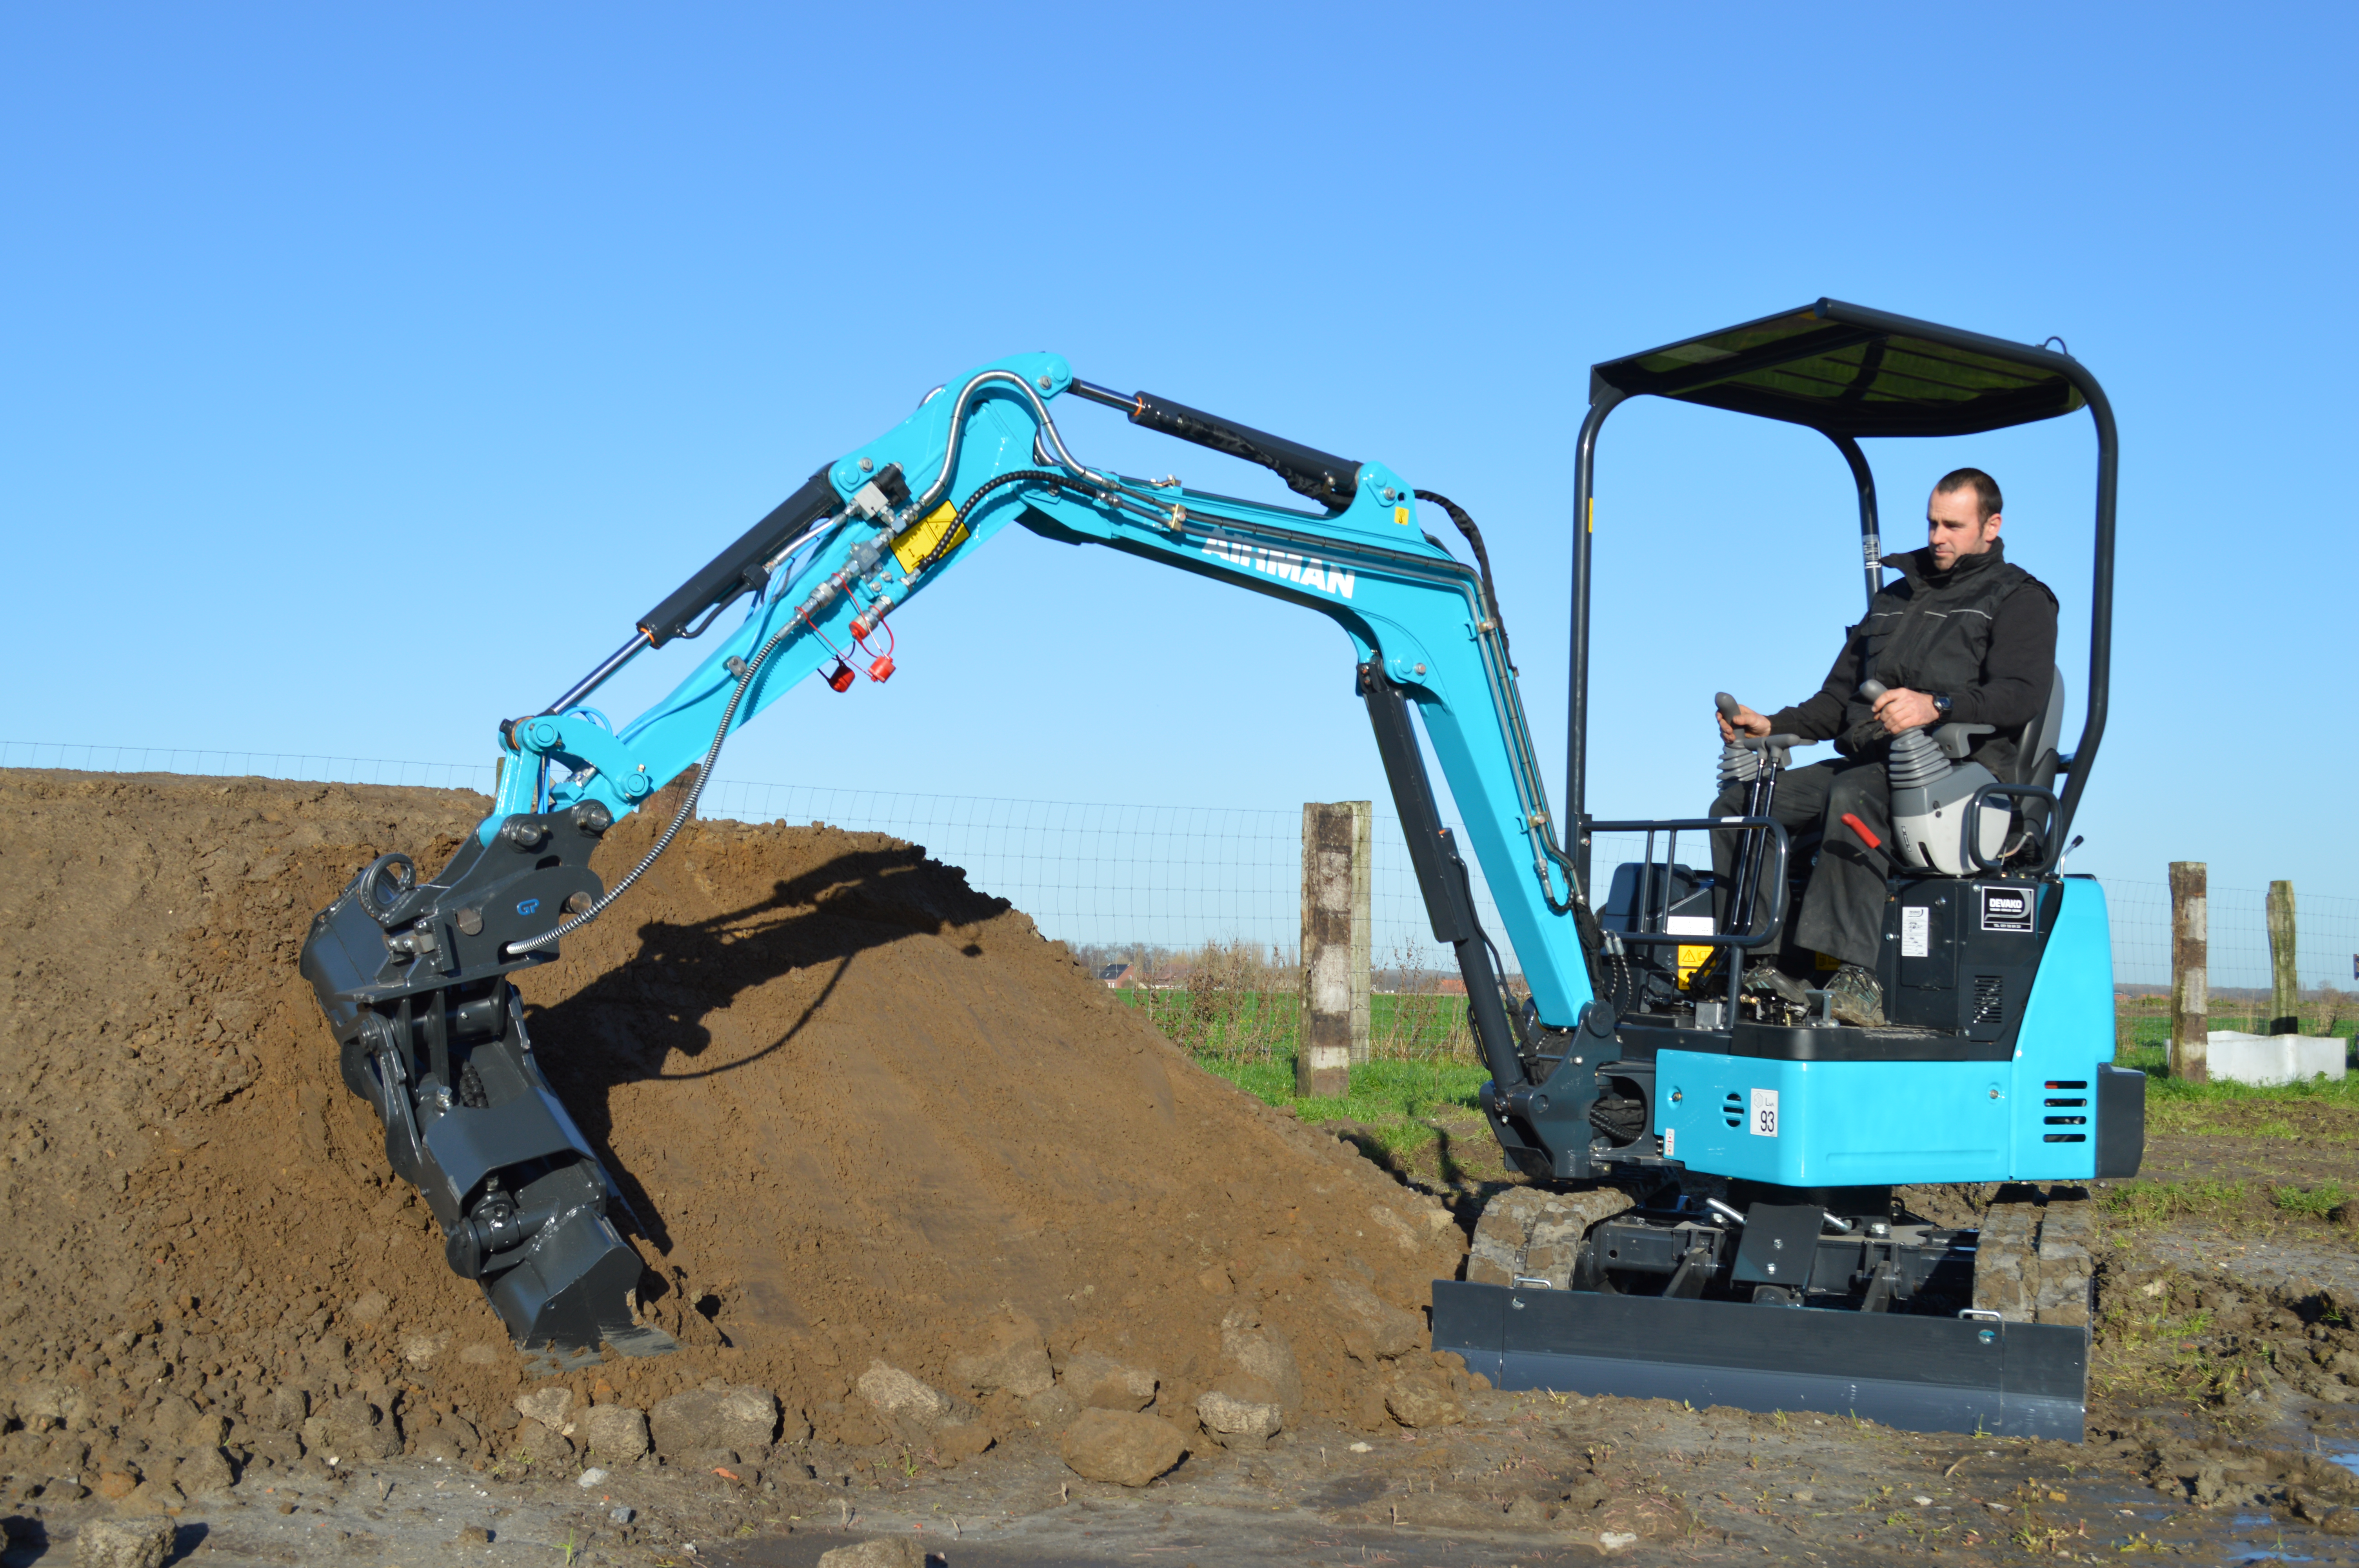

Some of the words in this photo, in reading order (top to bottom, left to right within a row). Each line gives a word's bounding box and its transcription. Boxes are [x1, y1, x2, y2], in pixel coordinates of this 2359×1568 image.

[1201, 527, 1355, 599] AIRMAN
[1989, 898, 2022, 909] DEVAKO
[1761, 1110, 1774, 1132] 93
